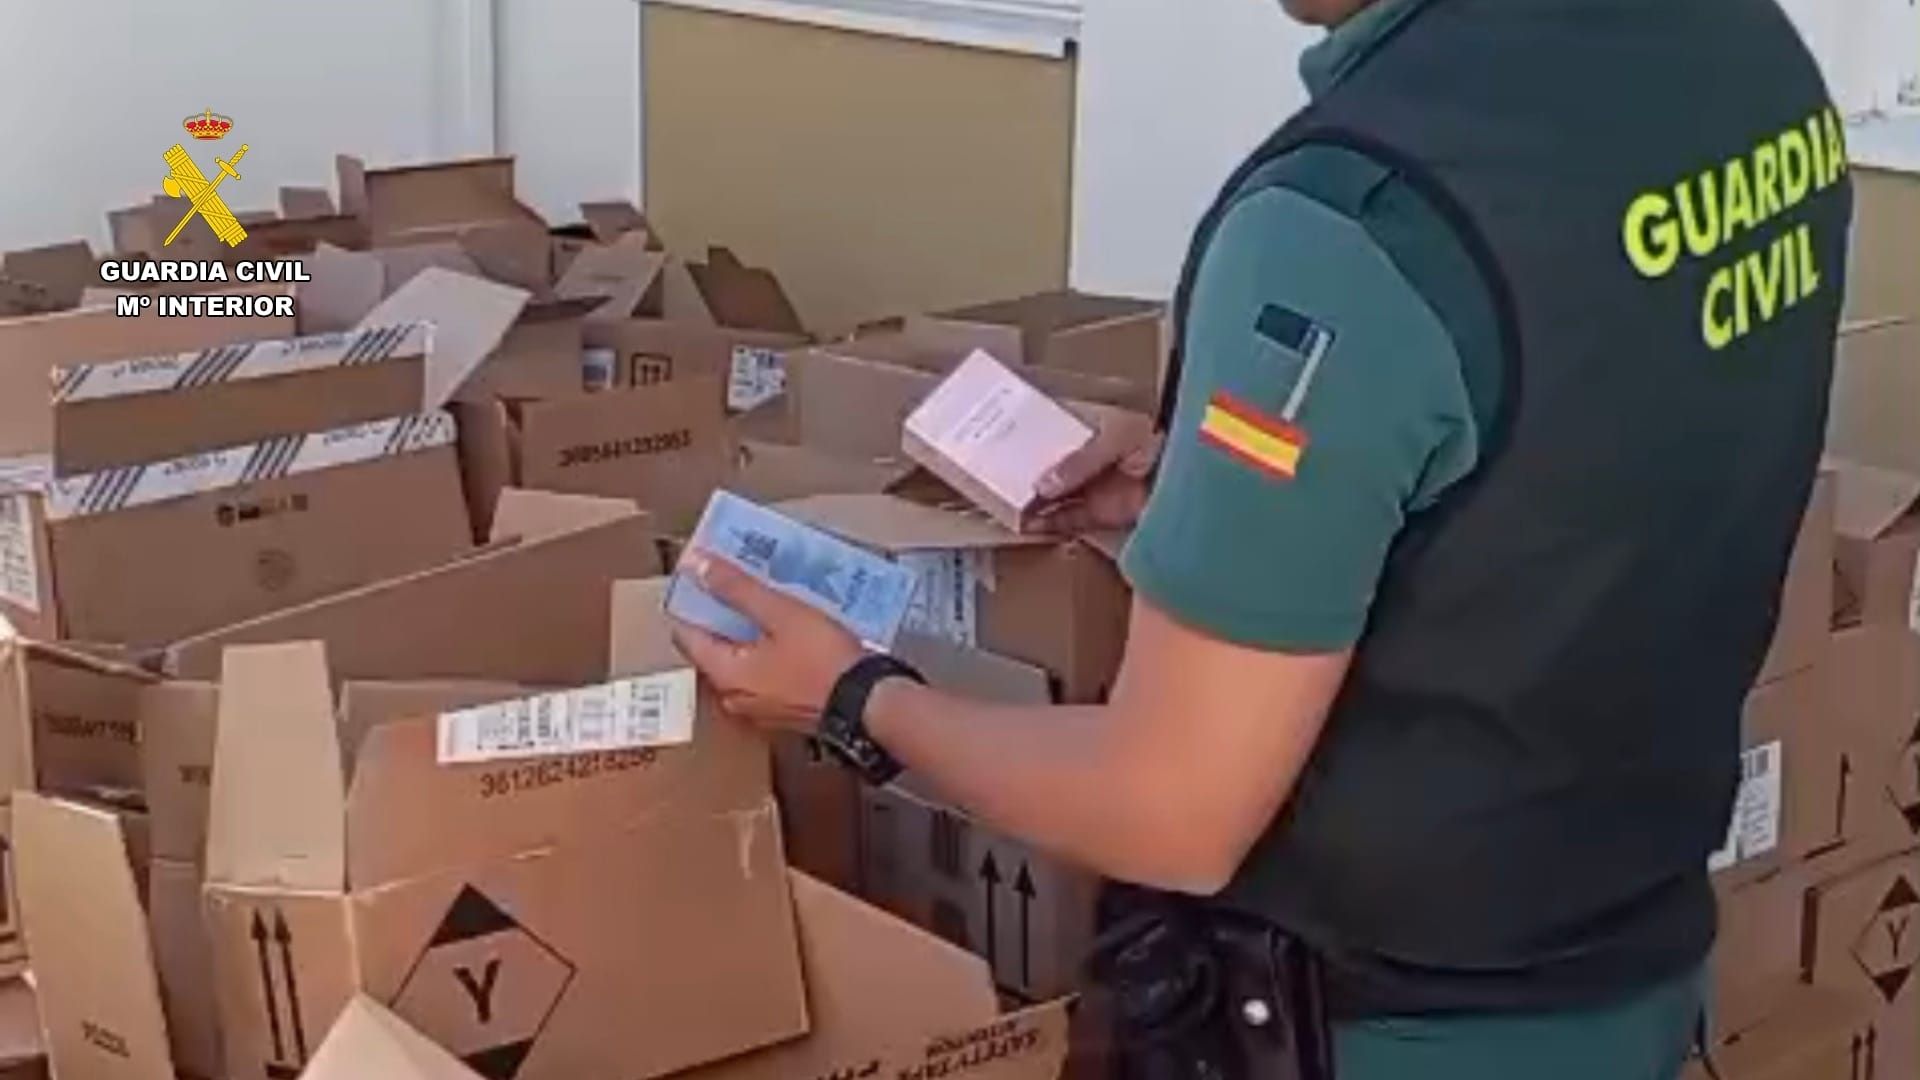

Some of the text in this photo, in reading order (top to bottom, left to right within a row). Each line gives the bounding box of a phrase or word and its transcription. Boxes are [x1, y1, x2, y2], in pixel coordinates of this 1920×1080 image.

[1623, 107, 1847, 277] GUARDIA
[1702, 224, 1820, 349] CIVIL
[453, 960, 501, 1024] Y
